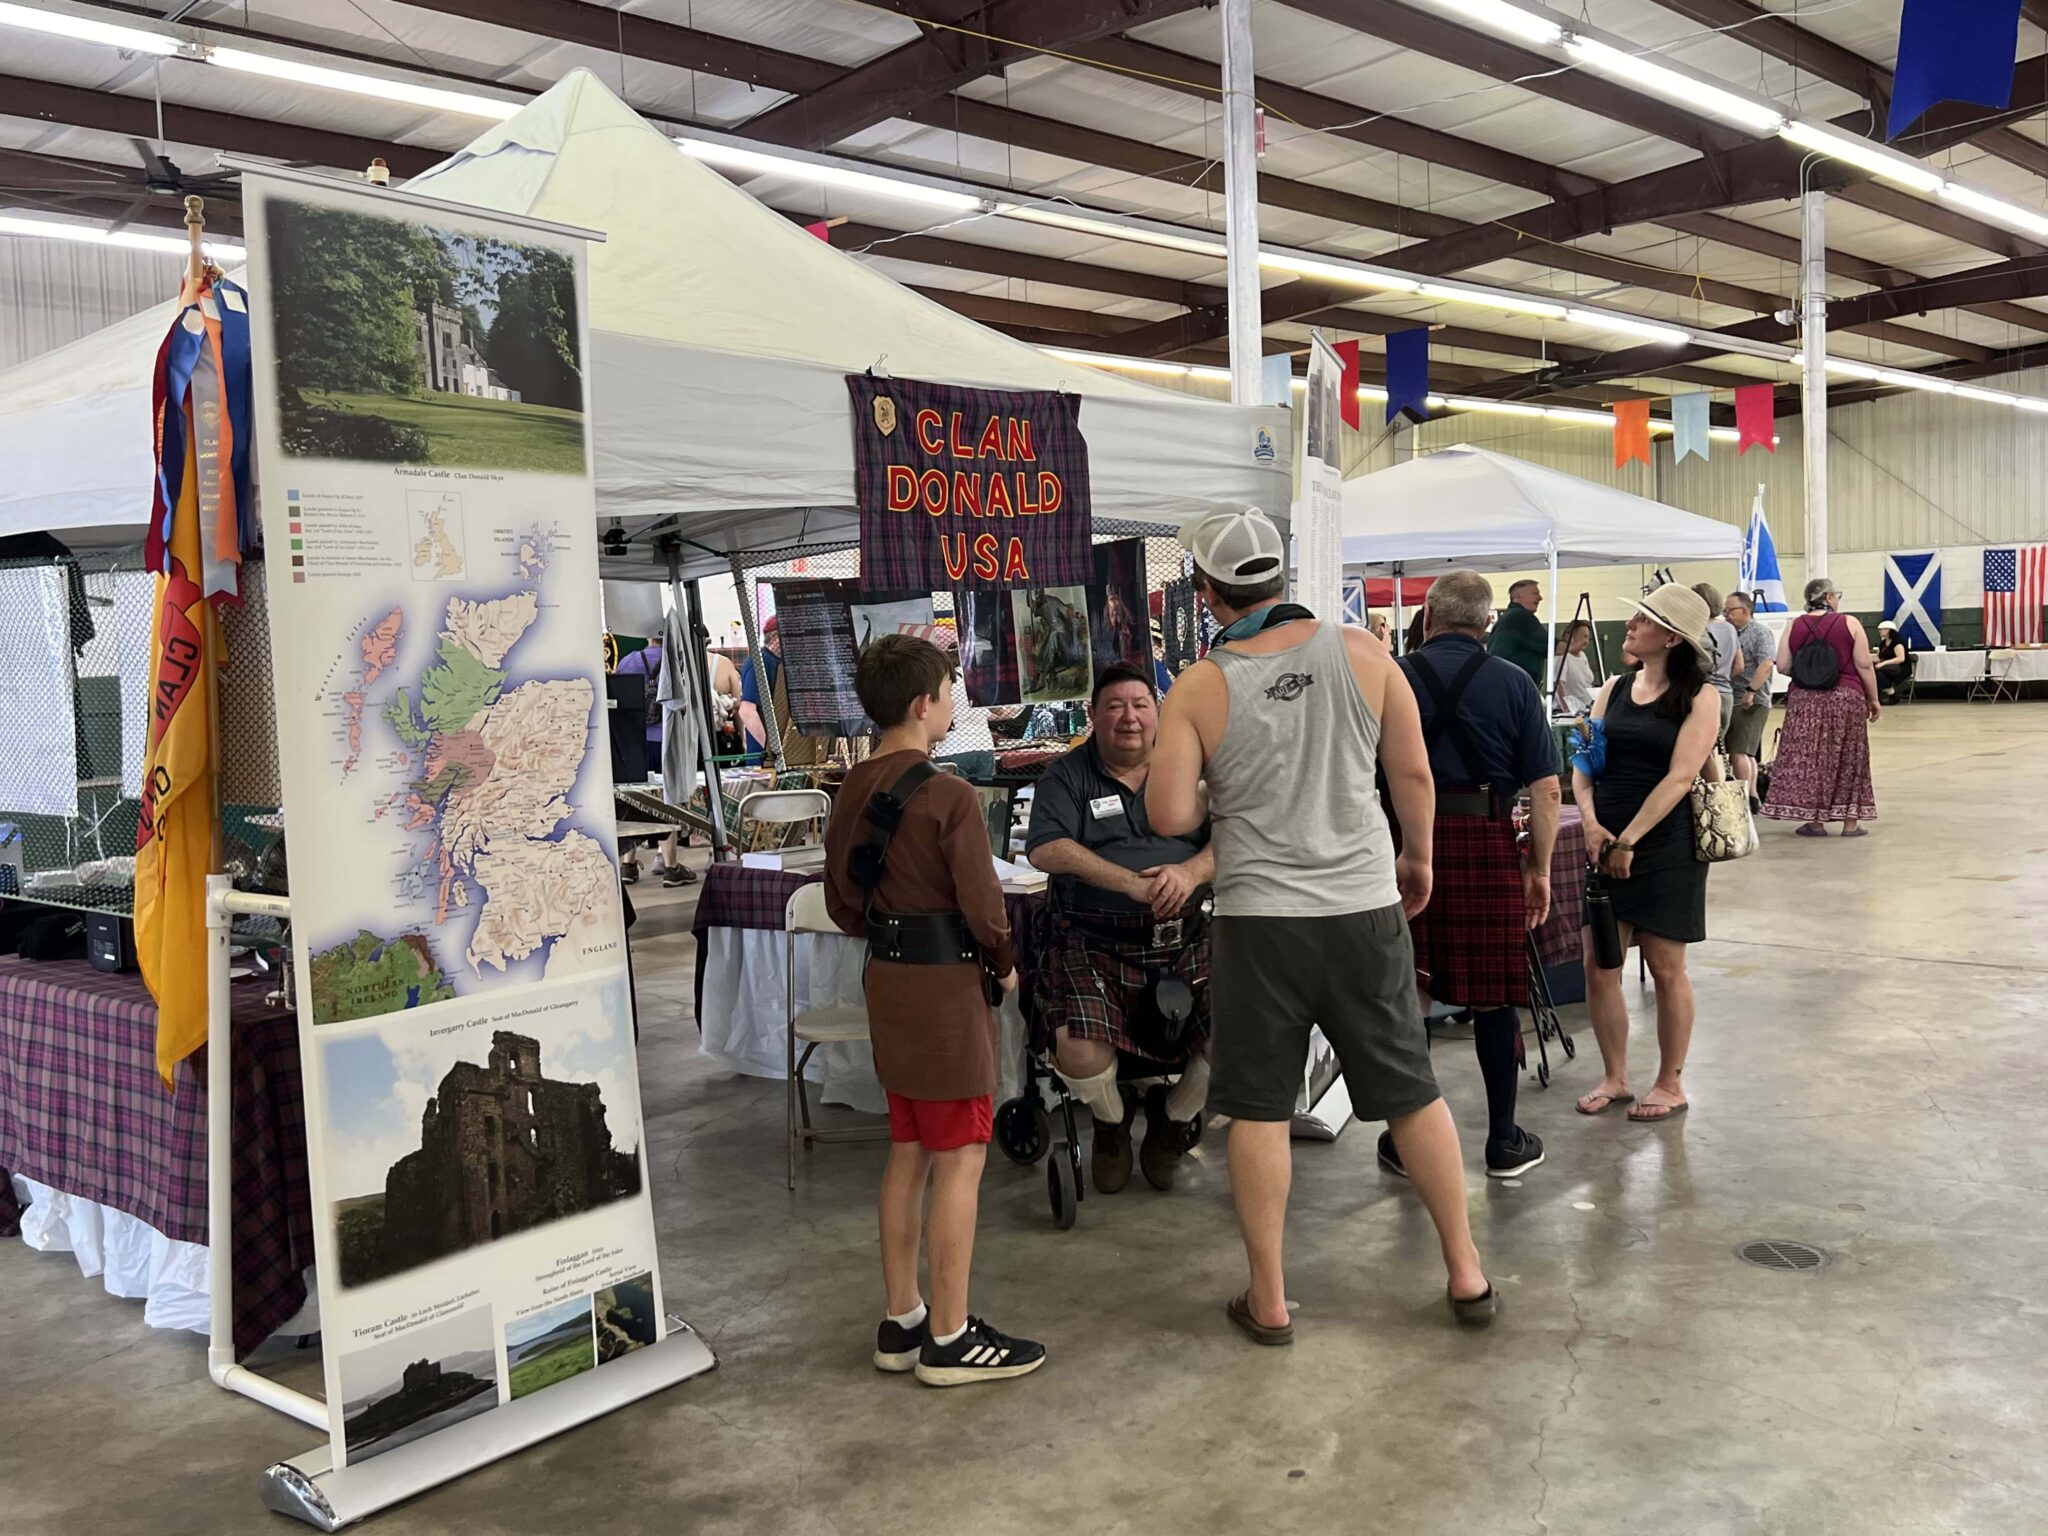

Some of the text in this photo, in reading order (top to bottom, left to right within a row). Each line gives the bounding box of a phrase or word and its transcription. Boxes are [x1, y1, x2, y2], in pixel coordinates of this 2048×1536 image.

[916, 408, 1036, 462] CLAN
[395, 468, 427, 477] Armadale
[428, 469, 451, 478] Castle
[454, 472, 468, 480] Clan
[887, 465, 1062, 518] DONALD
[940, 532, 1029, 581] USA
[582, 941, 618, 955] ENGLAND
[351, 991, 398, 1005] IRELAND
[429, 1023, 465, 1037] Invergarry
[466, 1017, 489, 1028] Castle
[511, 1007, 542, 1017] MacDonald
[573, 1261, 582, 1269] the
[582, 1257, 595, 1266] Lord
[516, 1307, 530, 1316] View
[530, 1303, 543, 1312] from
[352, 1323, 383, 1338] Tioram
[384, 1314, 408, 1327] Castle
